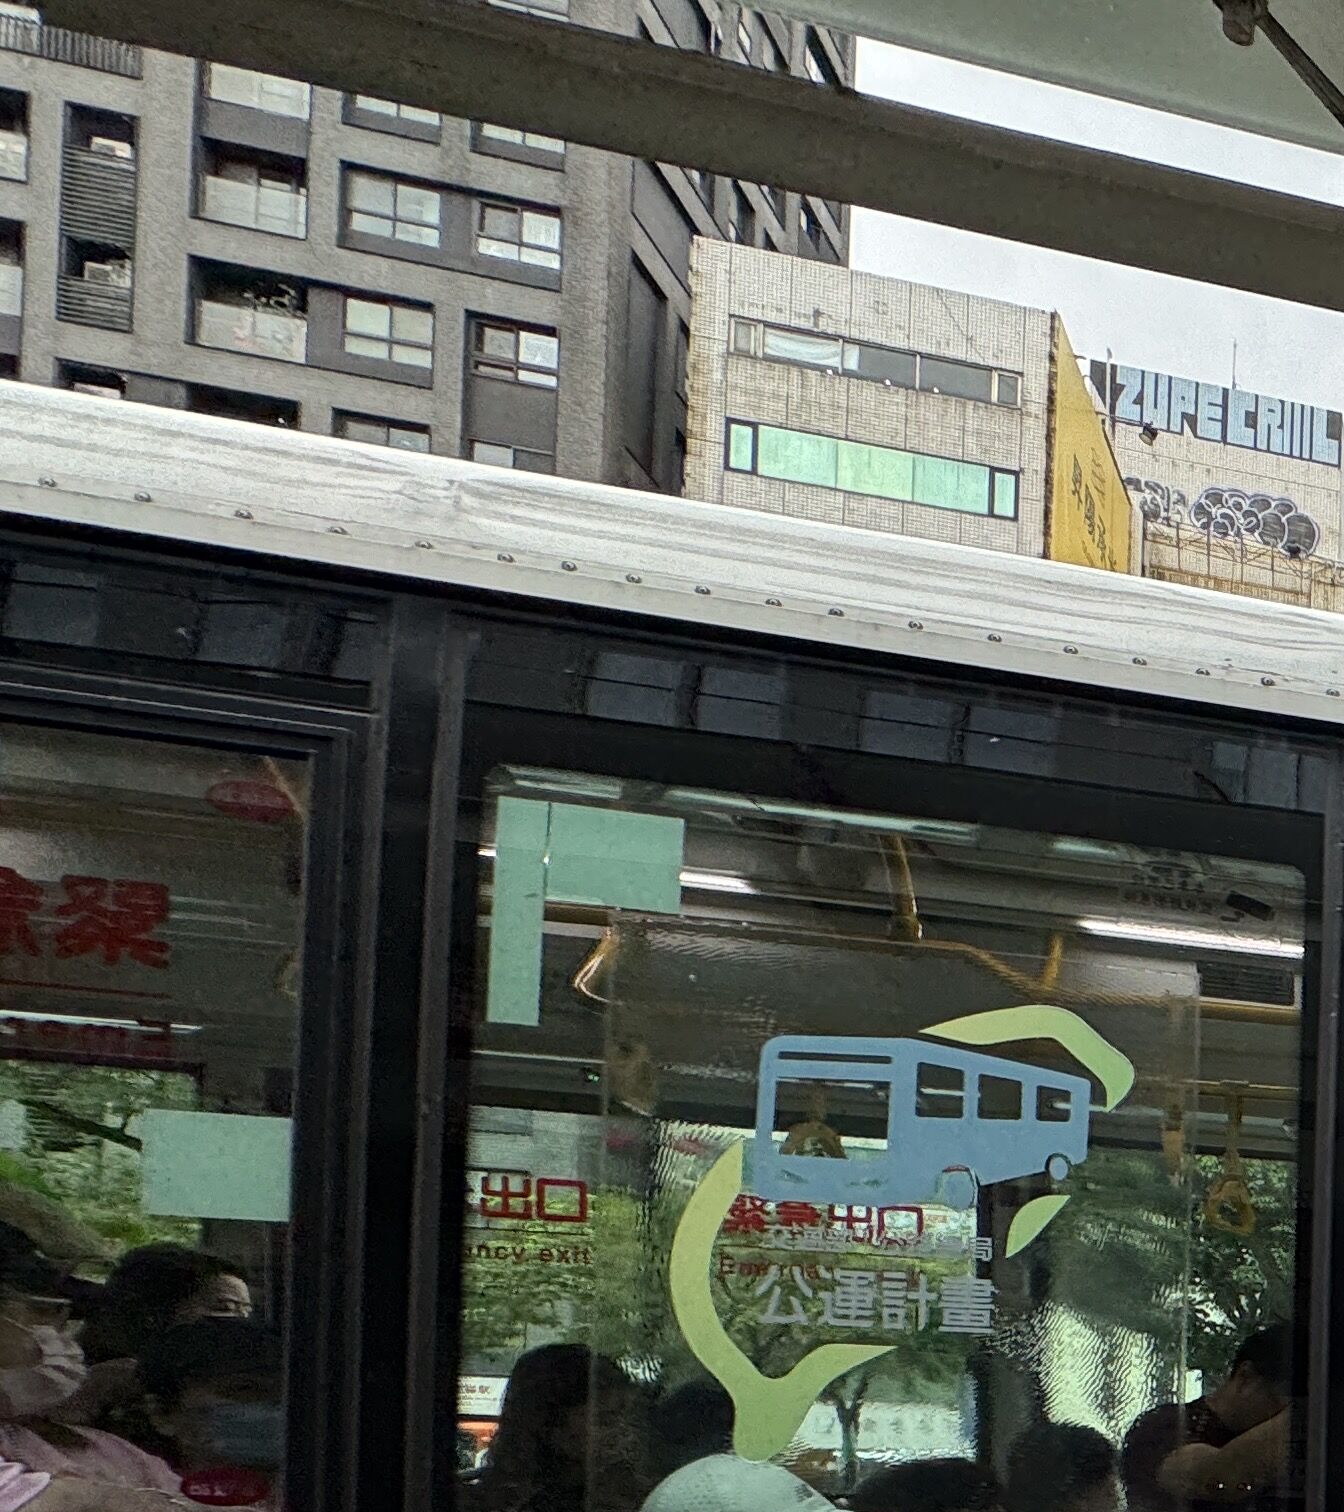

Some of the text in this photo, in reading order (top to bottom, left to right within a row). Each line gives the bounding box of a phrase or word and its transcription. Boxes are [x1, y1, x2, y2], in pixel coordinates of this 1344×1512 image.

[480, 1175, 588, 1223] 出口
[754, 1264, 995, 1333] 公運計畫
